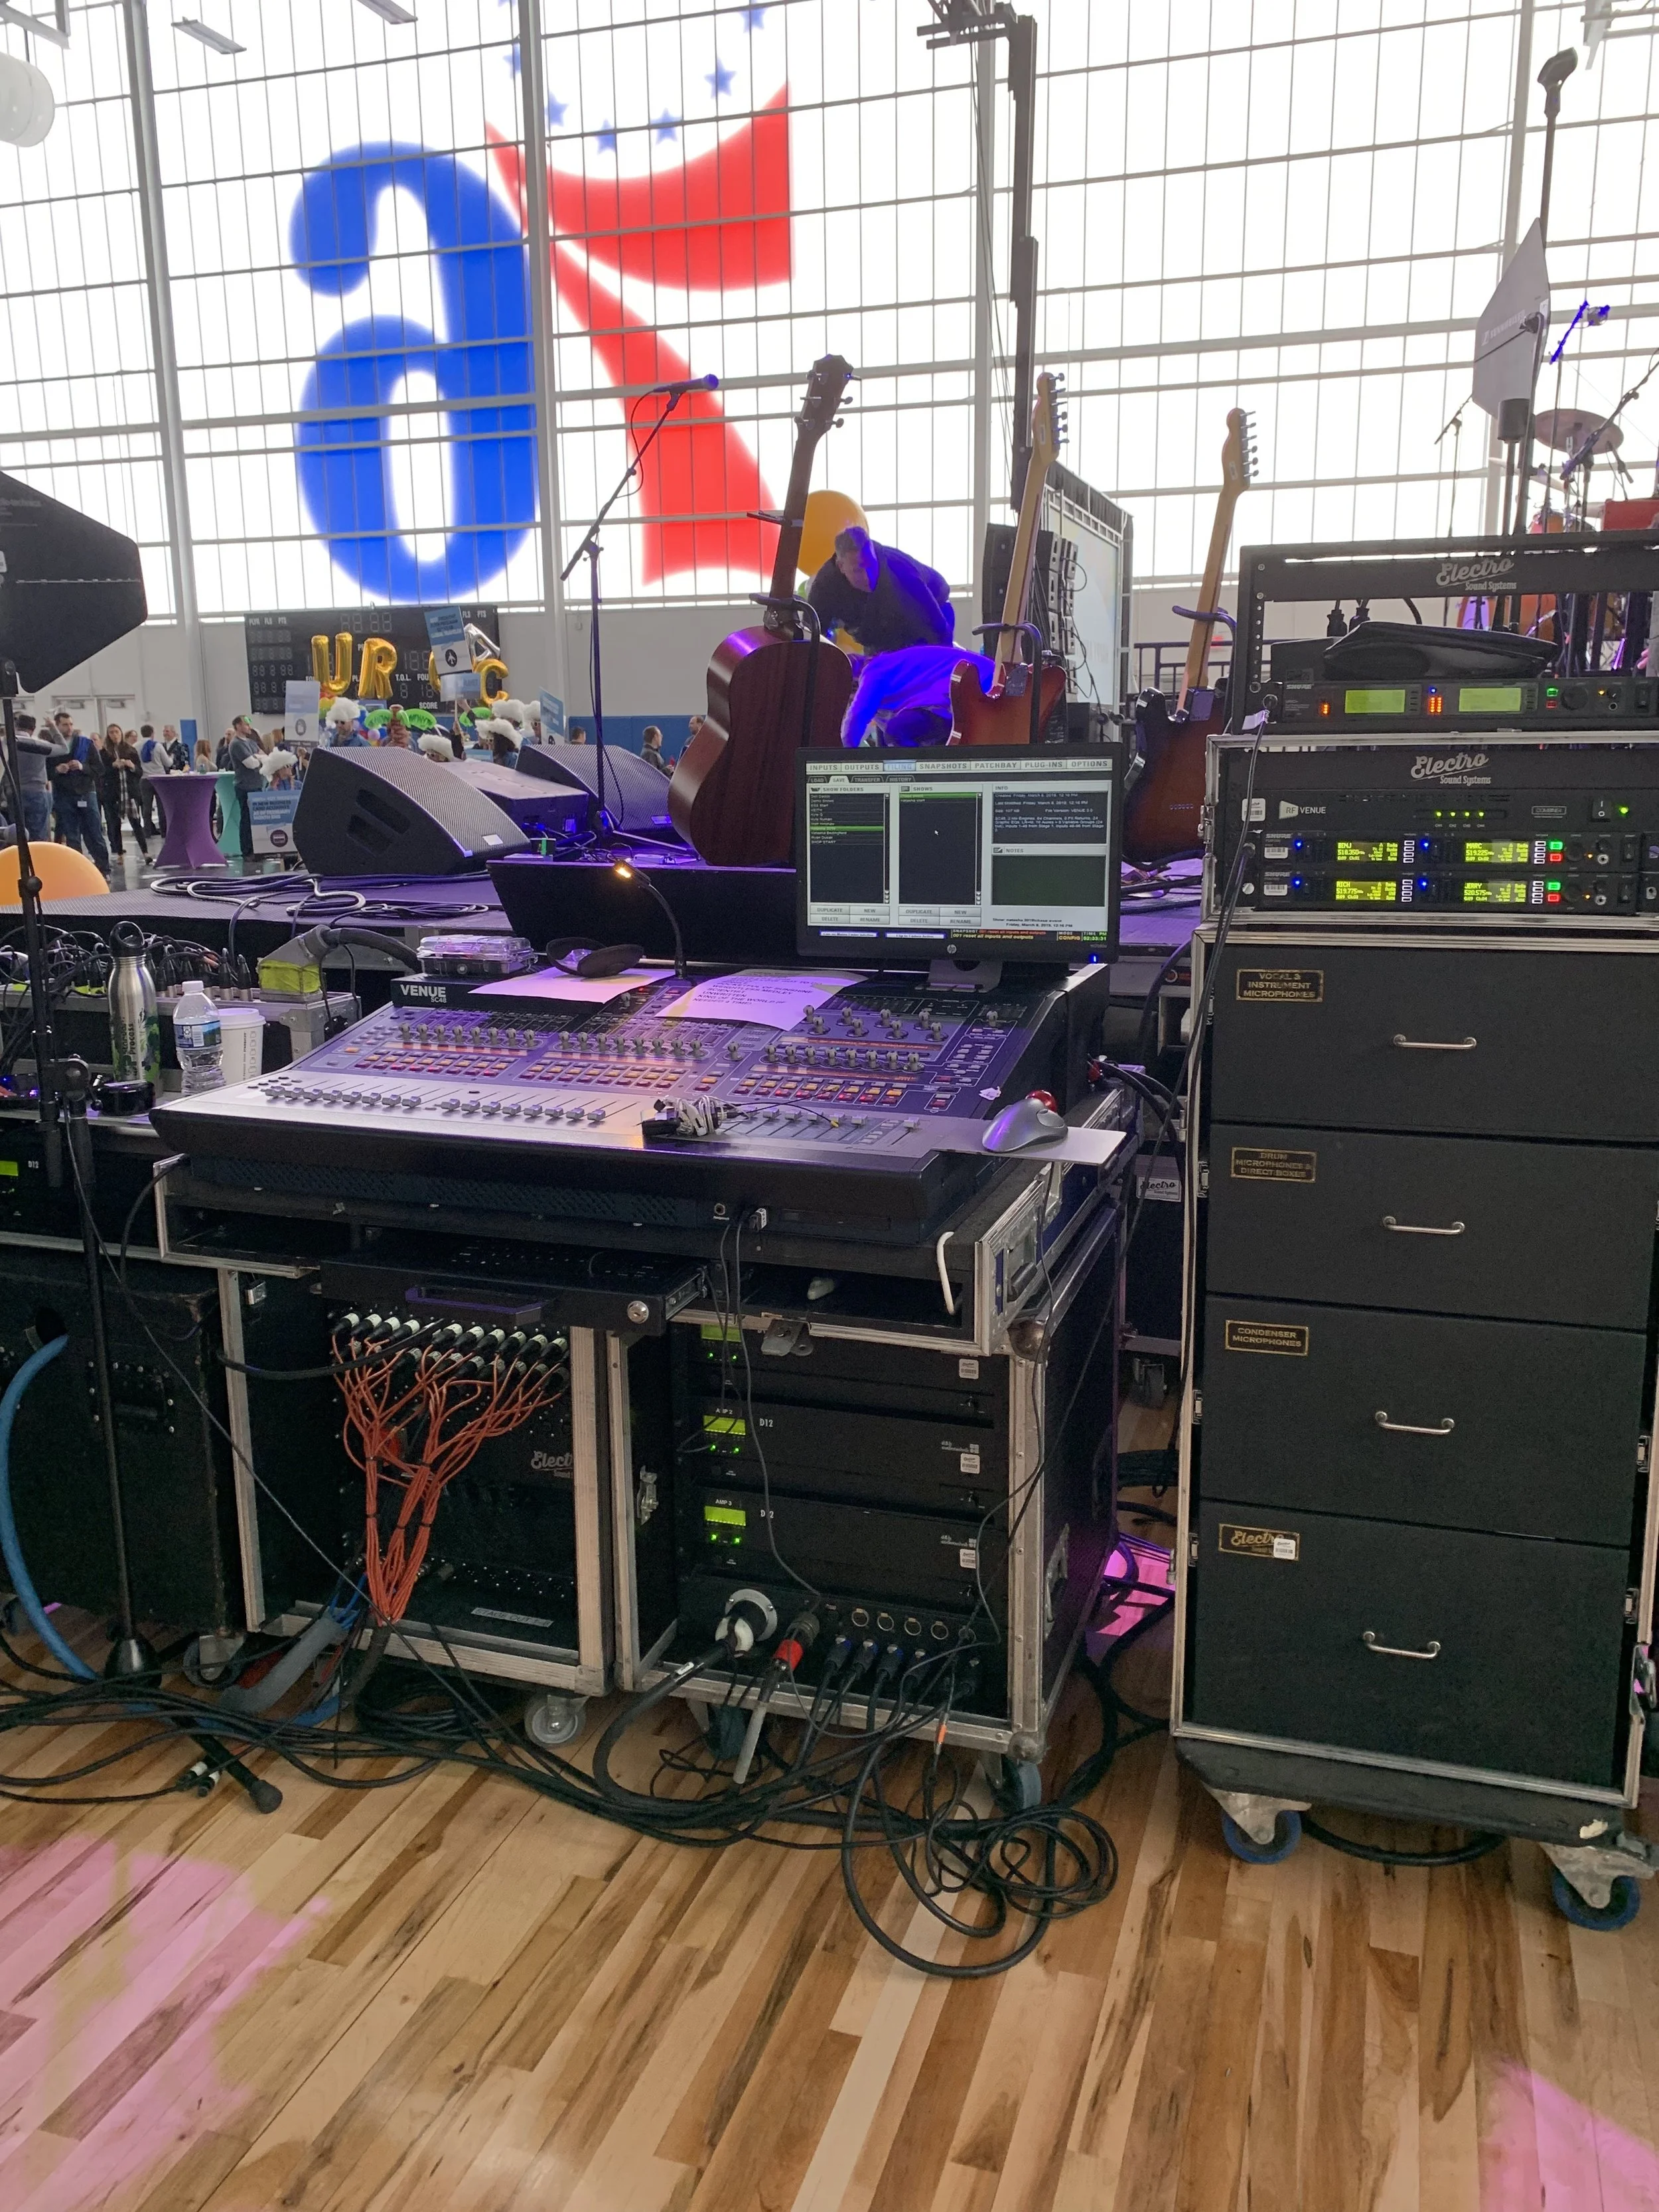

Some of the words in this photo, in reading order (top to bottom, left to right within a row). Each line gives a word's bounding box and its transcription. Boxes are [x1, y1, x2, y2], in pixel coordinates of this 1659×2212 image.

[1436, 558, 1515, 586] Electro
[1465, 581, 1486, 591] Sound
[1488, 581, 1517, 593] Systems
[1411, 752, 1489, 778] Electro
[1440, 775, 1461, 784] Sound
[1463, 776, 1491, 786] Systems
[400, 984, 446, 997] VENUE
[1243, 990, 1315, 998] MICROPHONES
[1236, 1159, 1305, 1169] MICROPHONES
[1241, 1167, 1274, 1176] DIRECT
[1275, 1169, 1306, 1177] BOXES
[1238, 1327, 1296, 1339] CONDENSER
[1232, 1335, 1301, 1347] MICROPHONES
[760, 1418, 773, 1427] D12
[531, 1450, 573, 1469] Elect
[760, 1510, 774, 1518] D2
